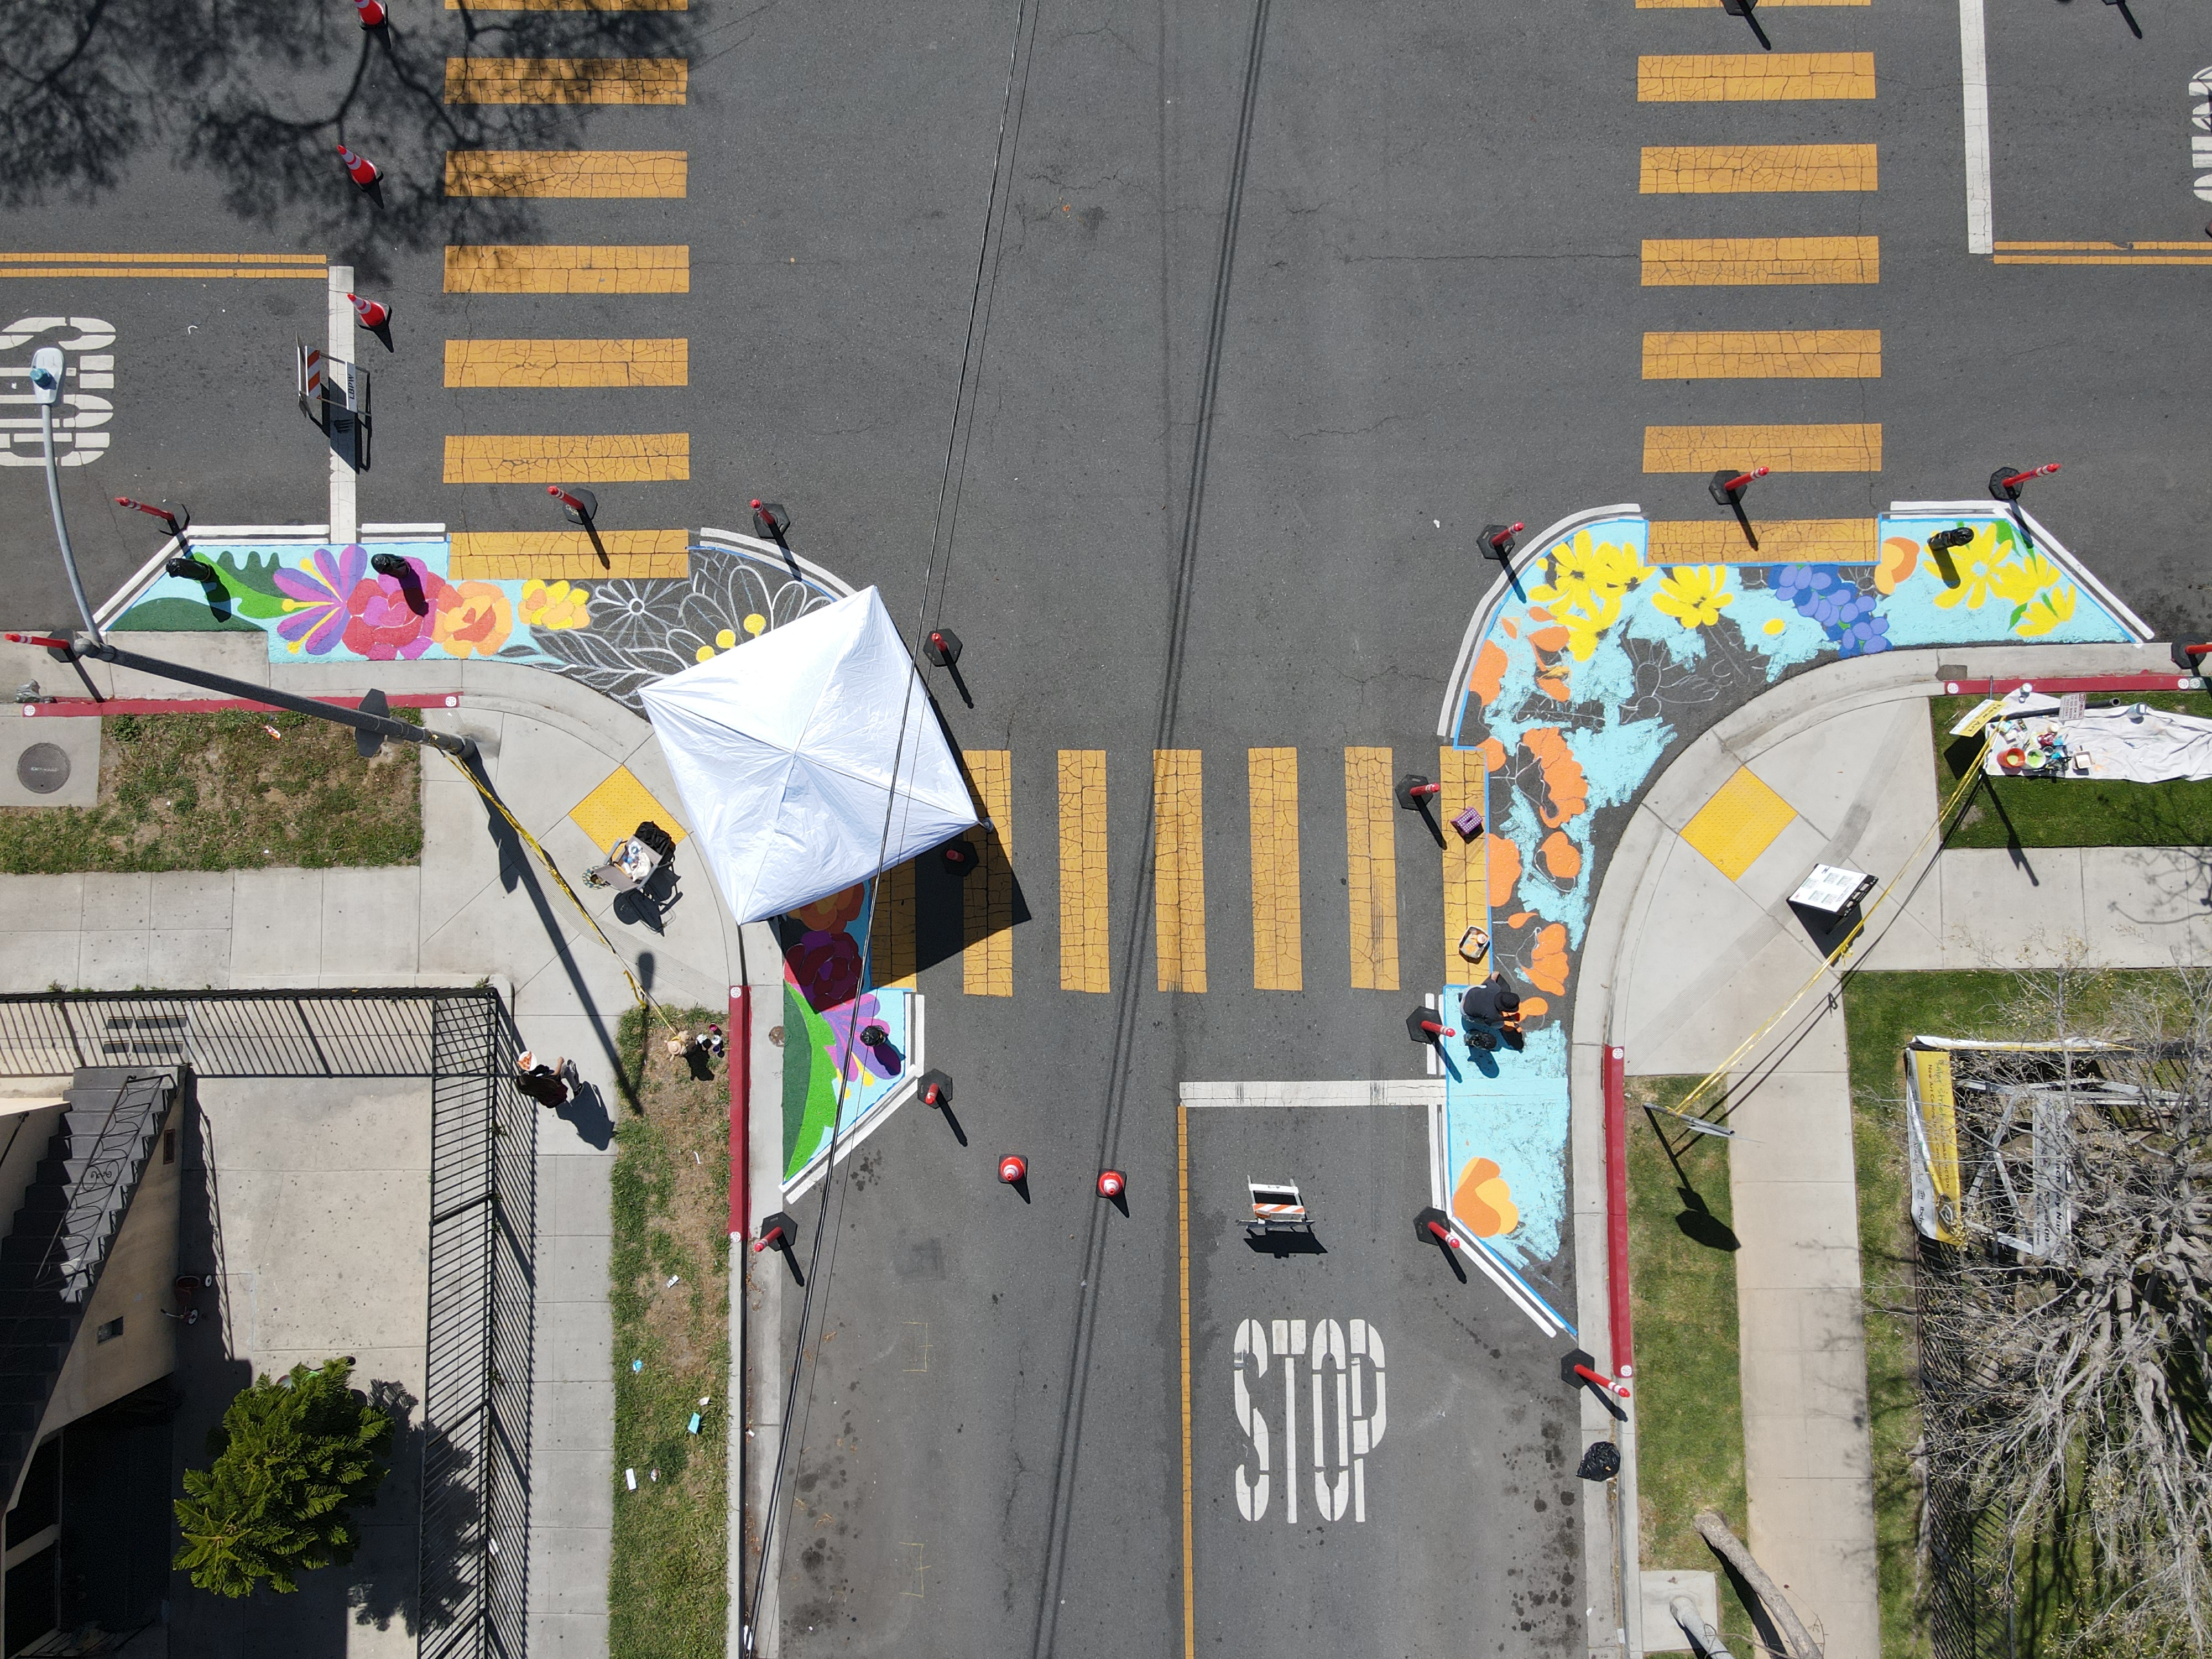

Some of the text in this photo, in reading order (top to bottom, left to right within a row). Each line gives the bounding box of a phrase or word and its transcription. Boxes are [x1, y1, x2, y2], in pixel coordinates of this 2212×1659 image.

[1983, 704, 2002, 719] New
[1968, 721, 1981, 732] Art
[1234, 1318, 1387, 1524] STOP
